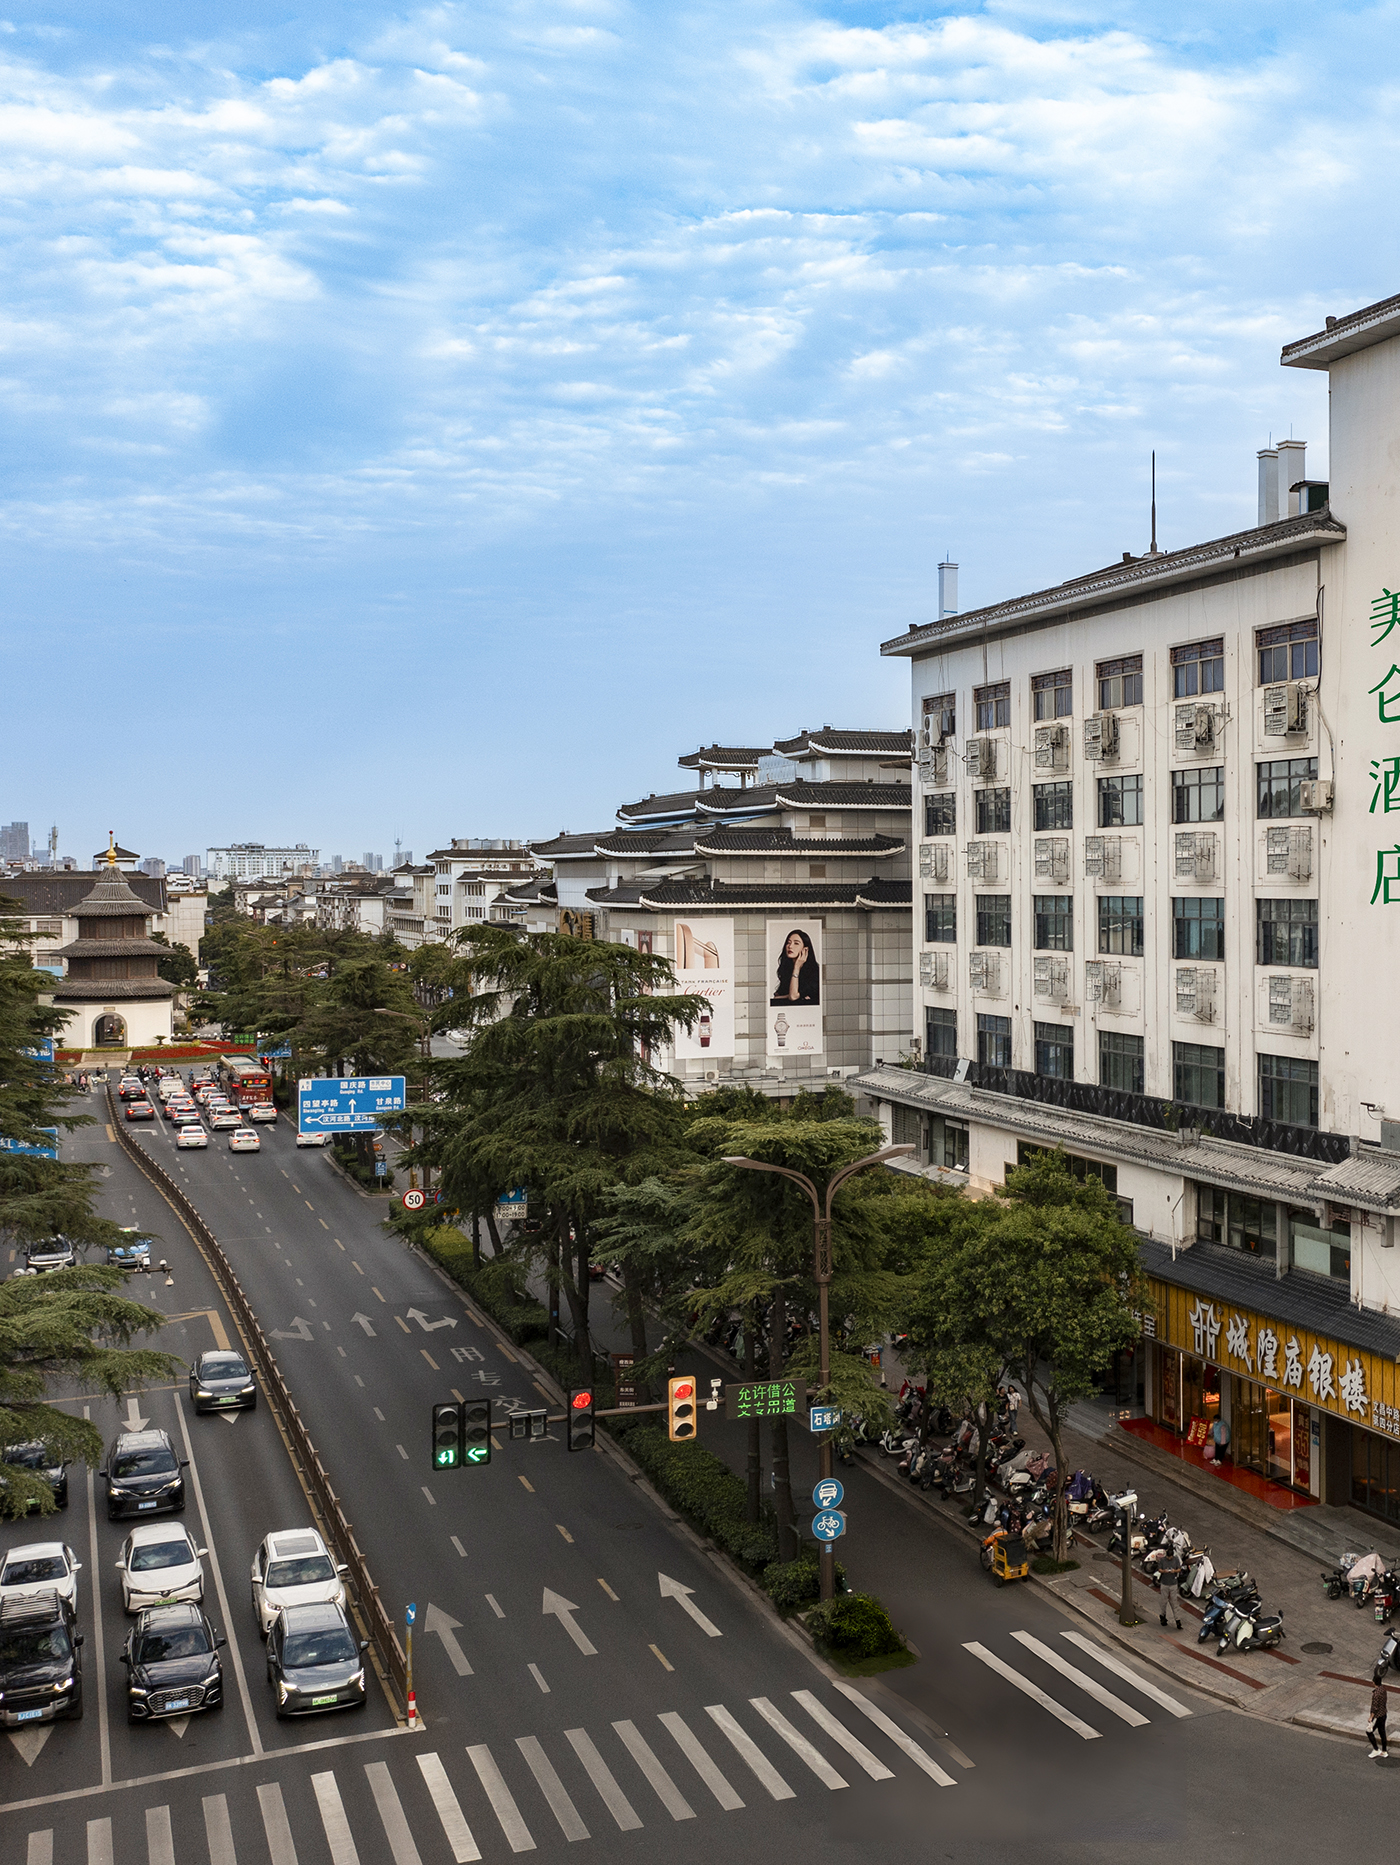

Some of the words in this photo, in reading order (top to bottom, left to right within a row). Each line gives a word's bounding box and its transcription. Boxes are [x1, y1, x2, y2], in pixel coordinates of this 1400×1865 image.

[683, 984, 726, 997] Cartier
[340, 1081, 366, 1089] 国庆路
[302, 1098, 339, 1108] 四望亭路
[375, 1096, 402, 1106] 甘泉路
[408, 1194, 421, 1205] 50
[1225, 1313, 1369, 1417] 城隍庙银楼
[737, 1382, 797, 1401] 允许借公
